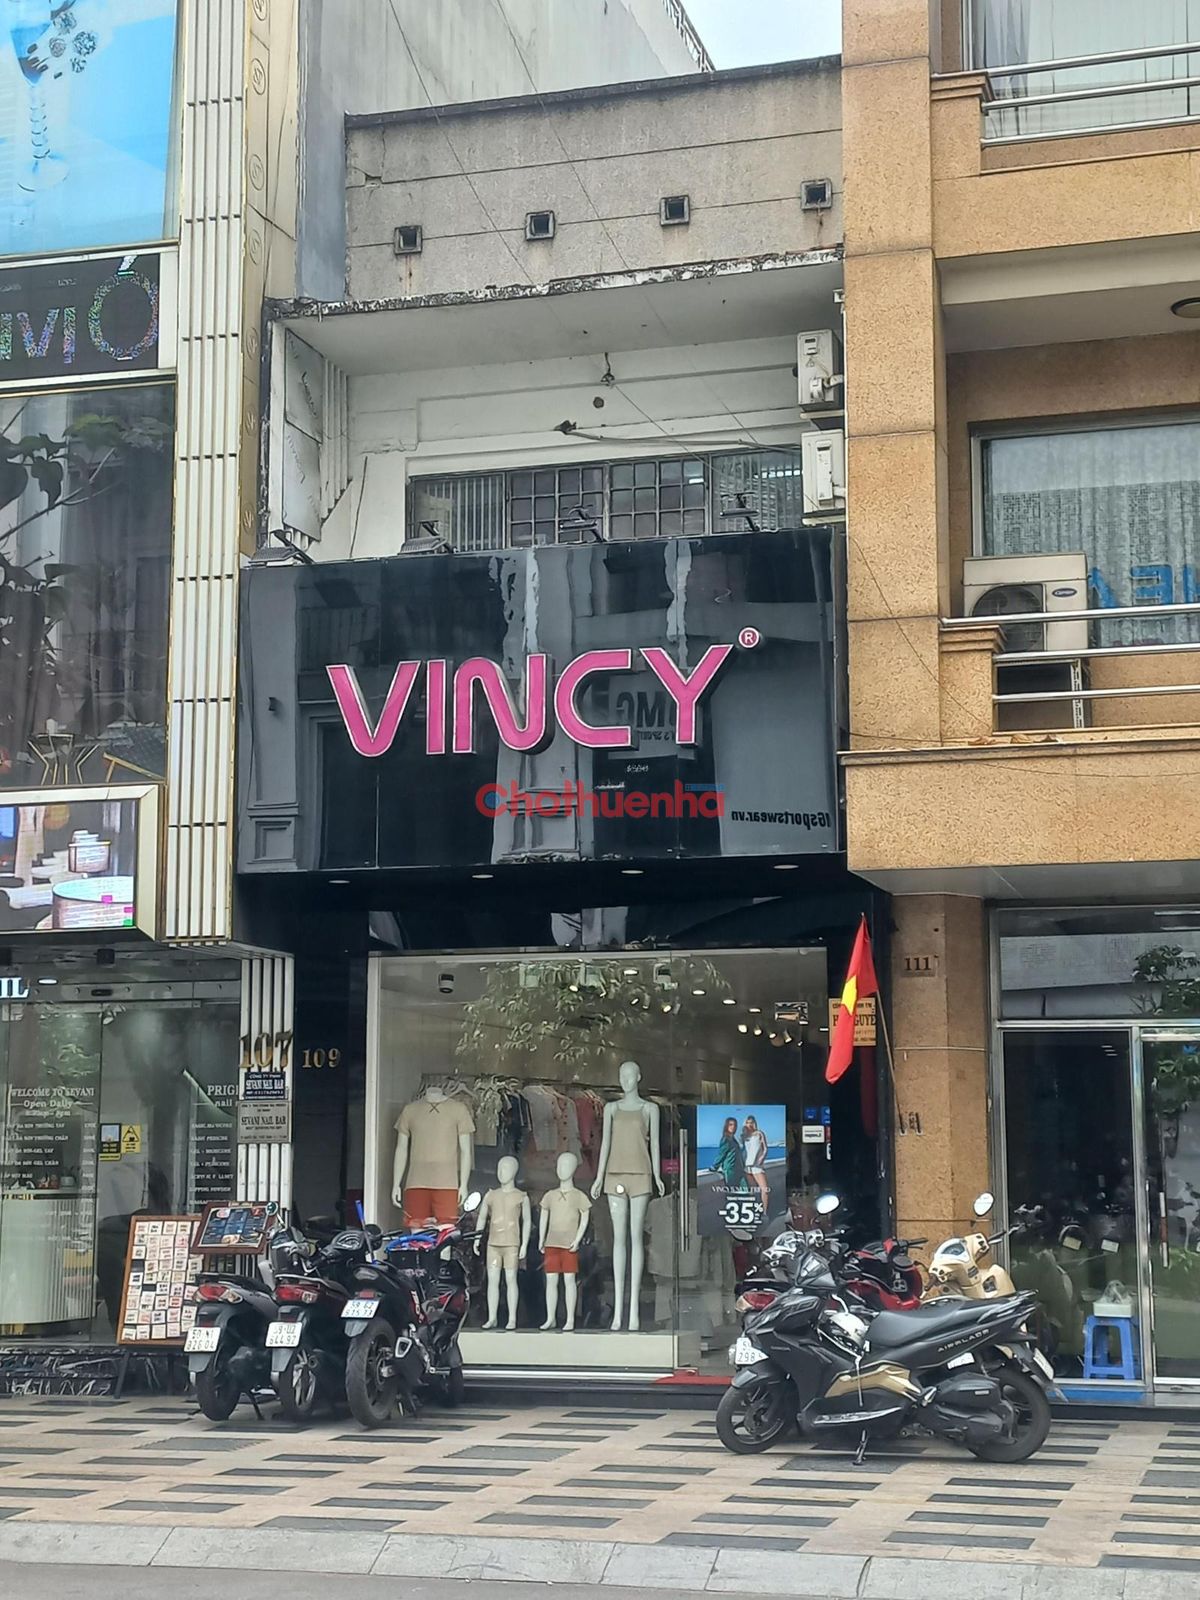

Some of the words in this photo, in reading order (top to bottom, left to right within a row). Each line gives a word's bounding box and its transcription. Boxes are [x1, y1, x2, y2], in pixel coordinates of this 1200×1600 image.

[326, 644, 734, 757] VINCY
[904, 957, 931, 971] 111
[239, 1031, 292, 1069] 107
[302, 1048, 341, 1069] 109
[23, 1100, 47, 1109] Open
